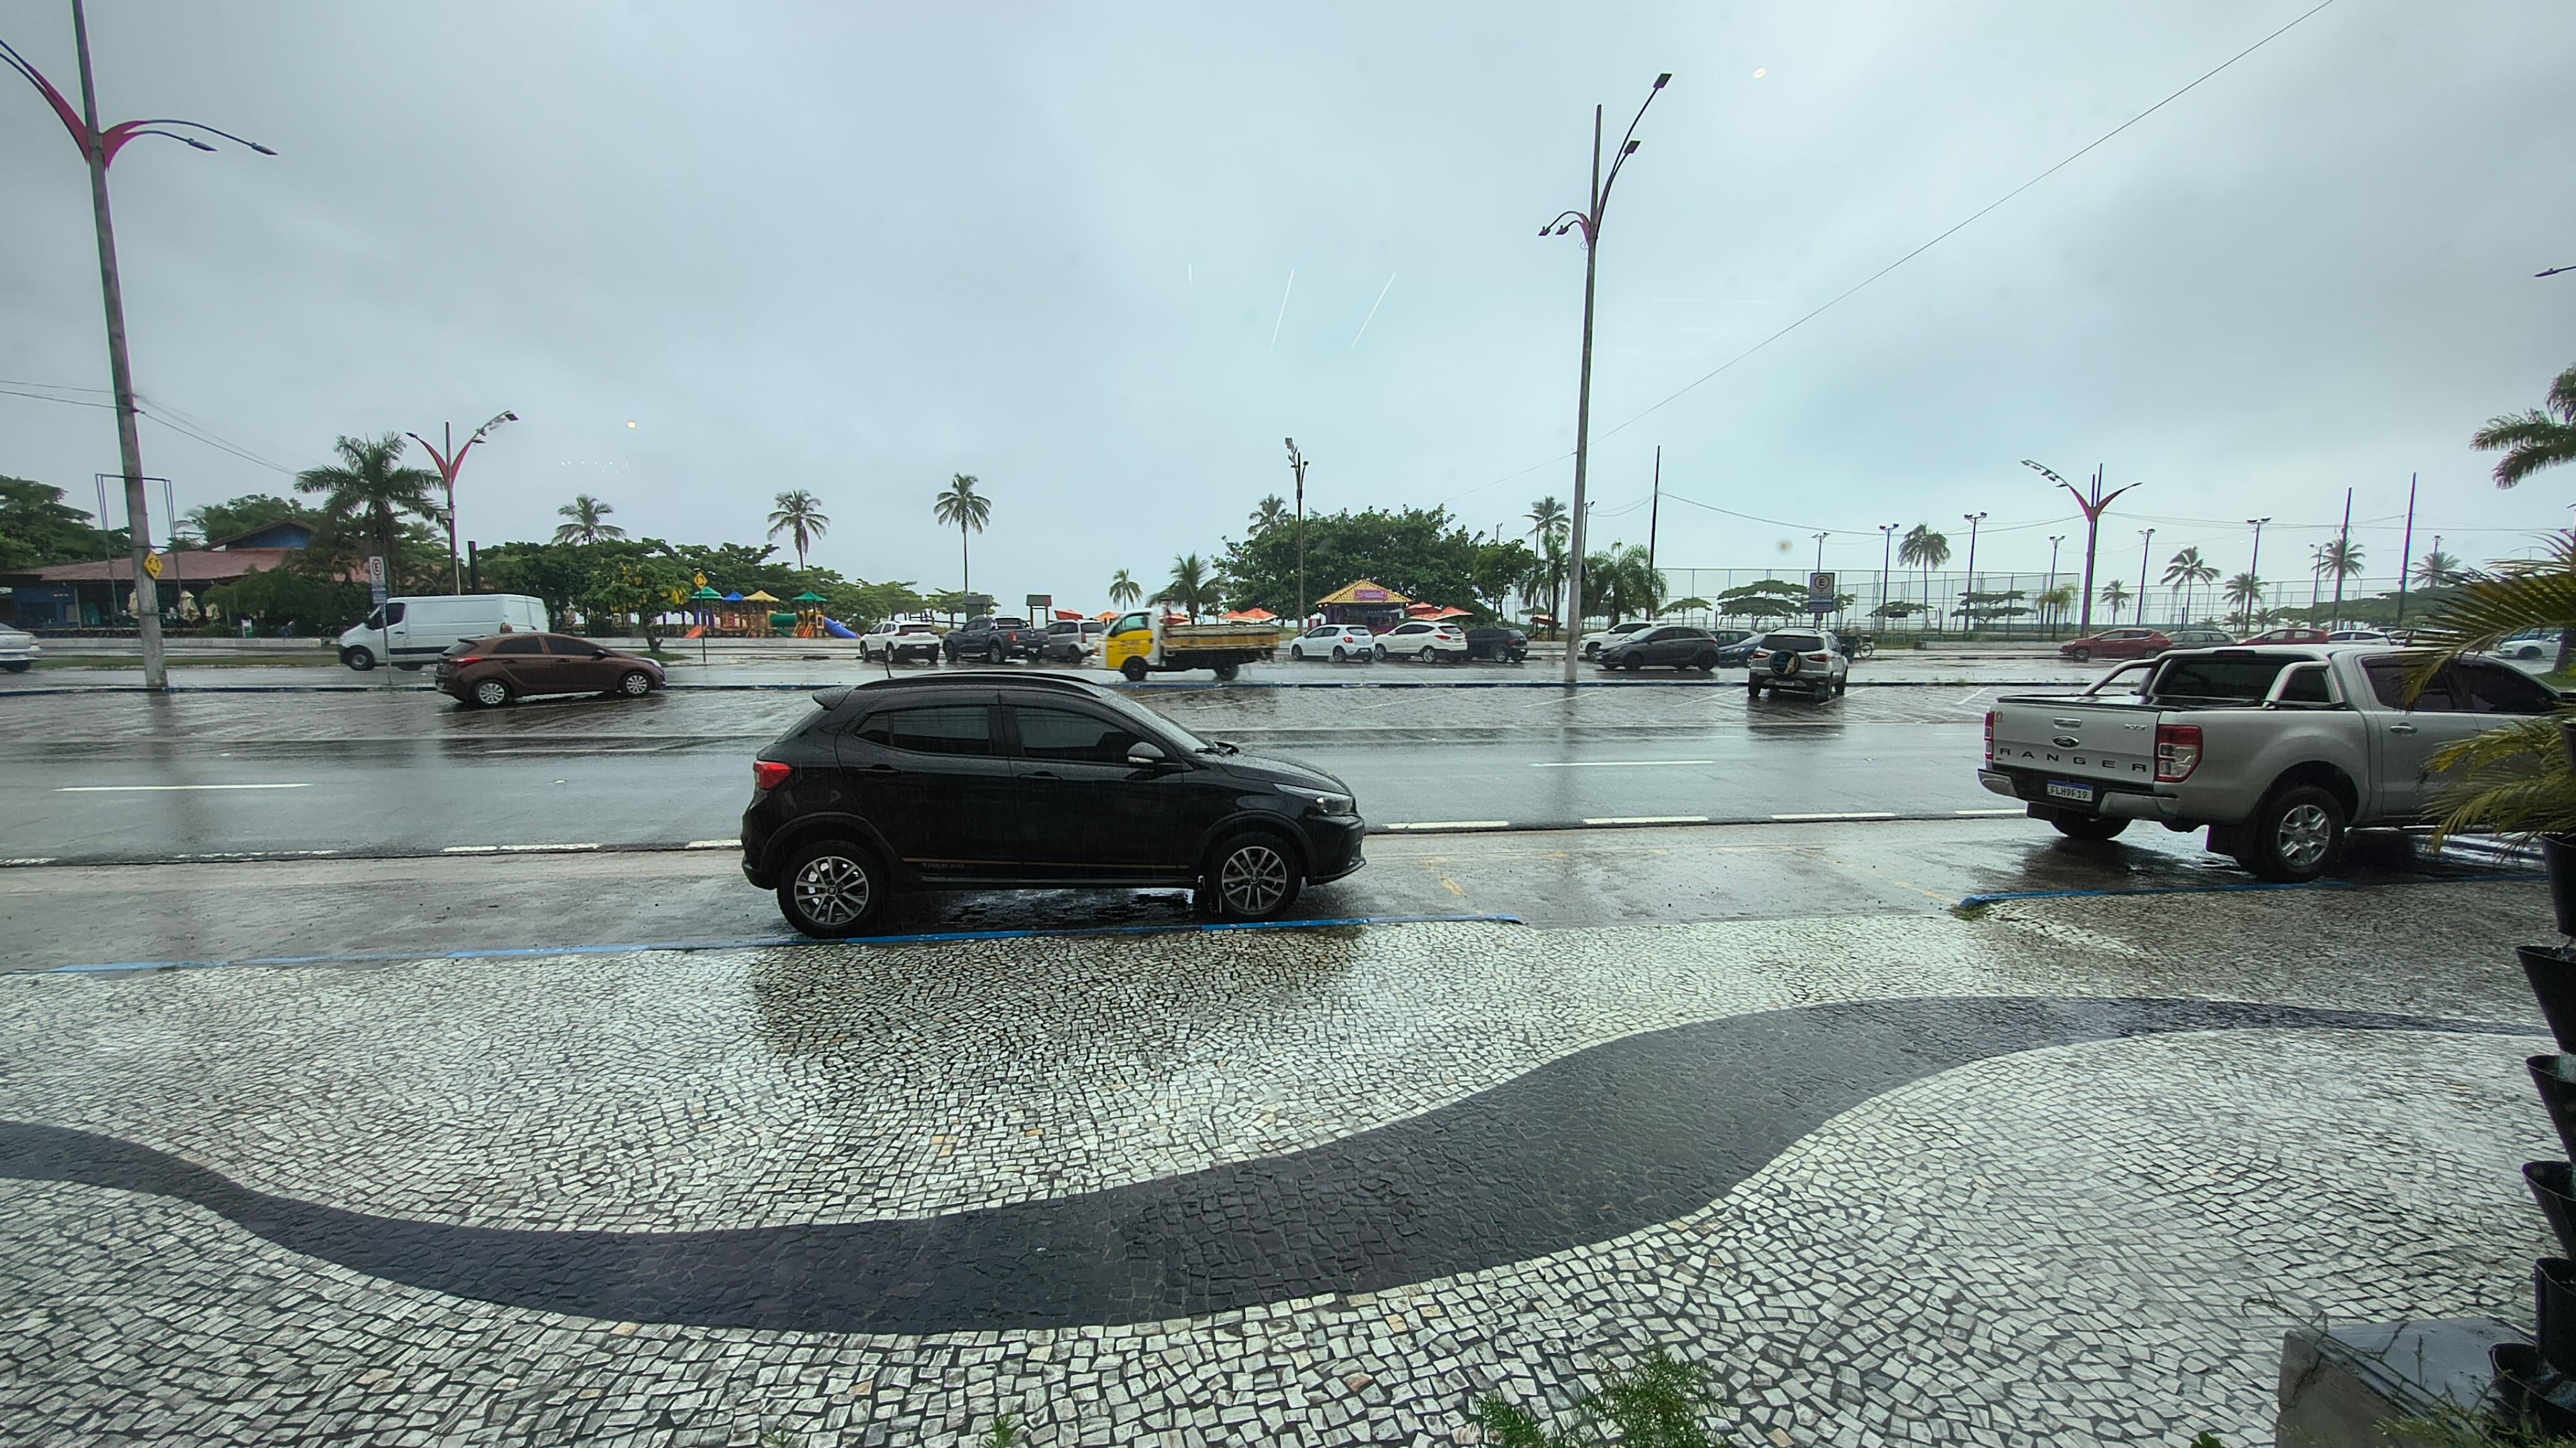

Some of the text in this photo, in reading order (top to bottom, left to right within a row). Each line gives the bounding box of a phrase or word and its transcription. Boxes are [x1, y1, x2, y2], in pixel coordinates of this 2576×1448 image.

[1819, 578, 1825, 586] E
[2000, 748, 2147, 773] RANGER
[2050, 786, 2087, 799] FLH9F19
